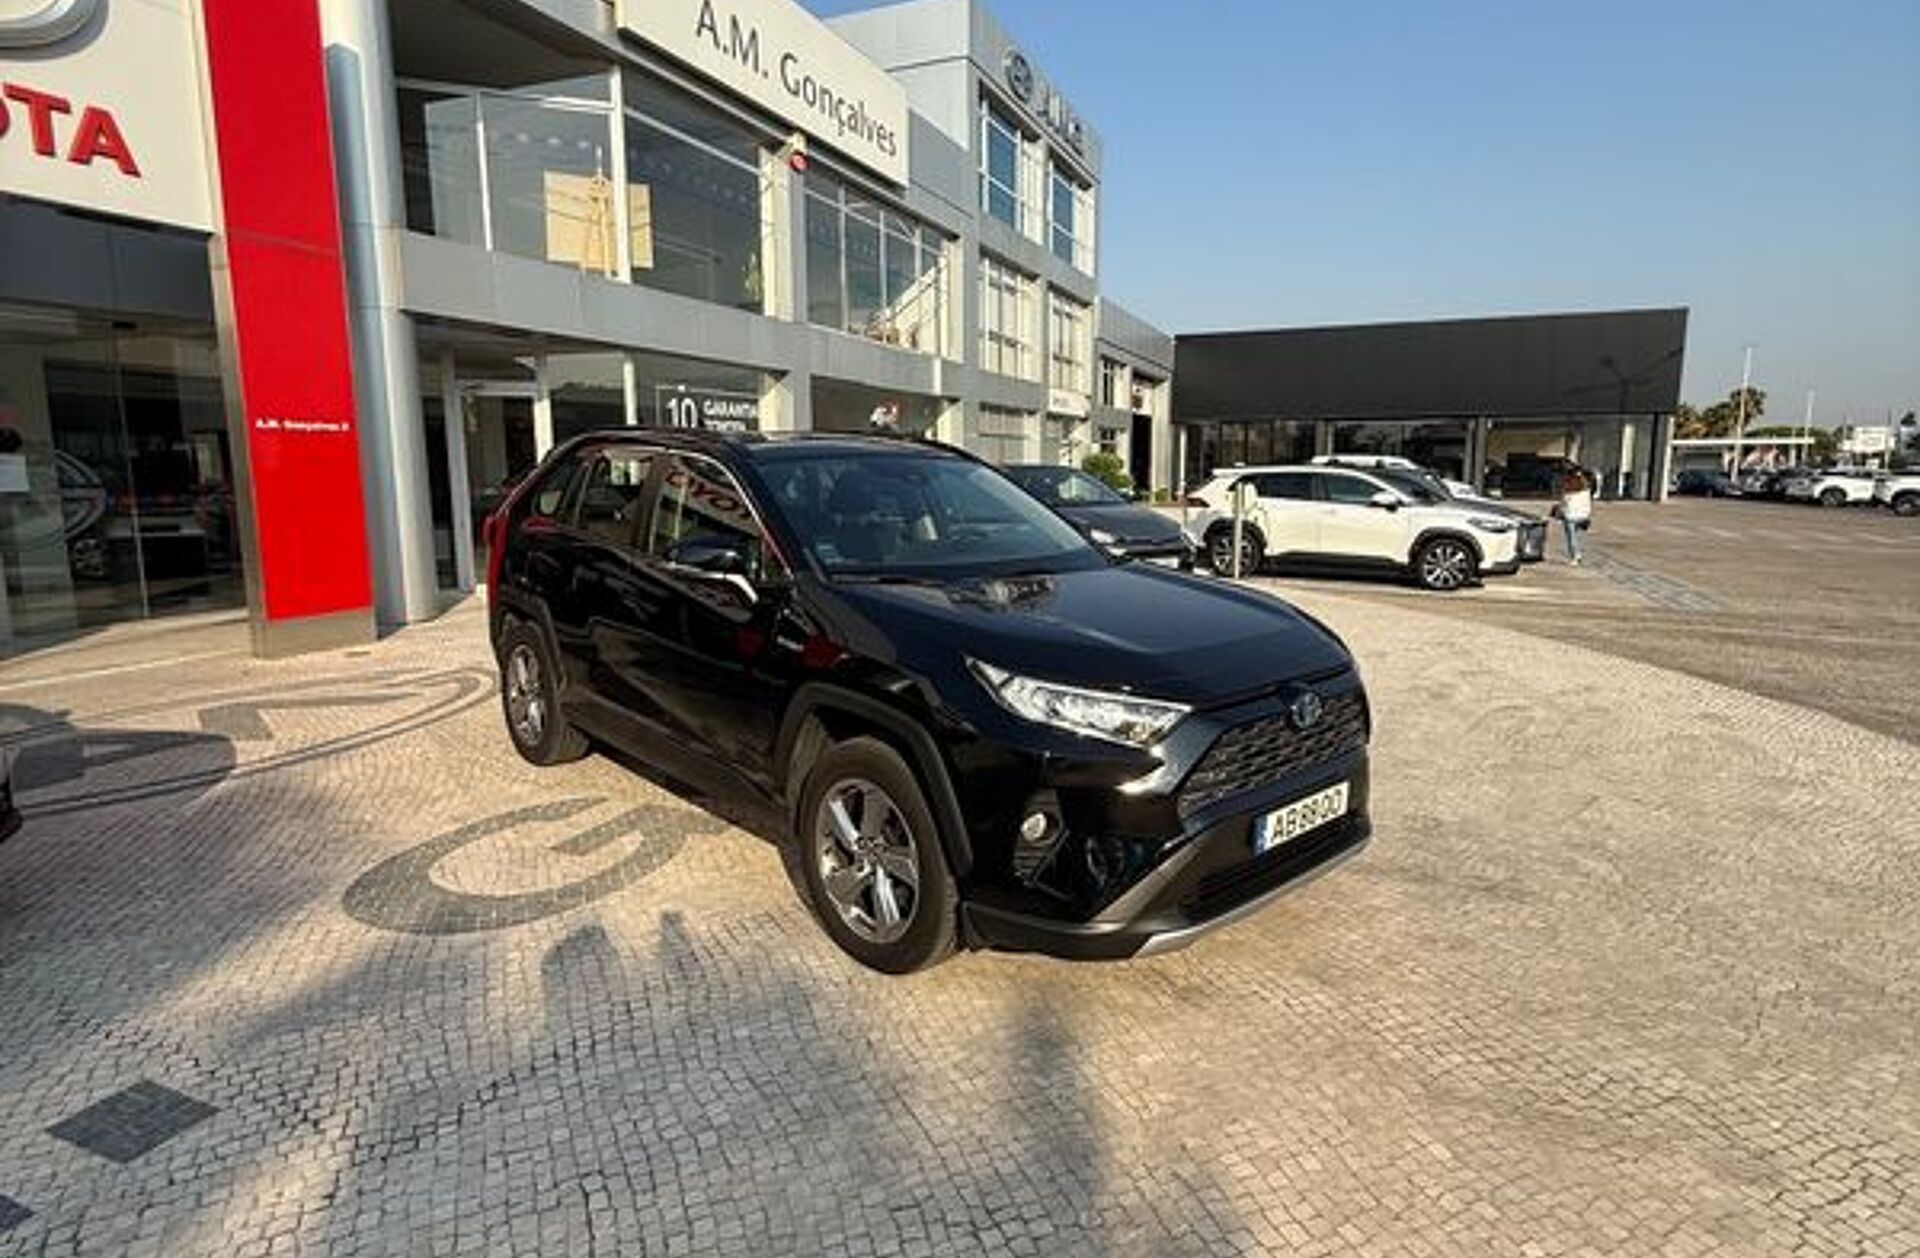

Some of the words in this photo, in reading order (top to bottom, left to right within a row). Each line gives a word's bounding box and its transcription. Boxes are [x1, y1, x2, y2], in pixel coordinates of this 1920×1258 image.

[697, 0, 768, 79] A.M.
[780, 52, 897, 157] Gonçalves
[0, 81, 142, 178] TA
[666, 397, 699, 429] 10
